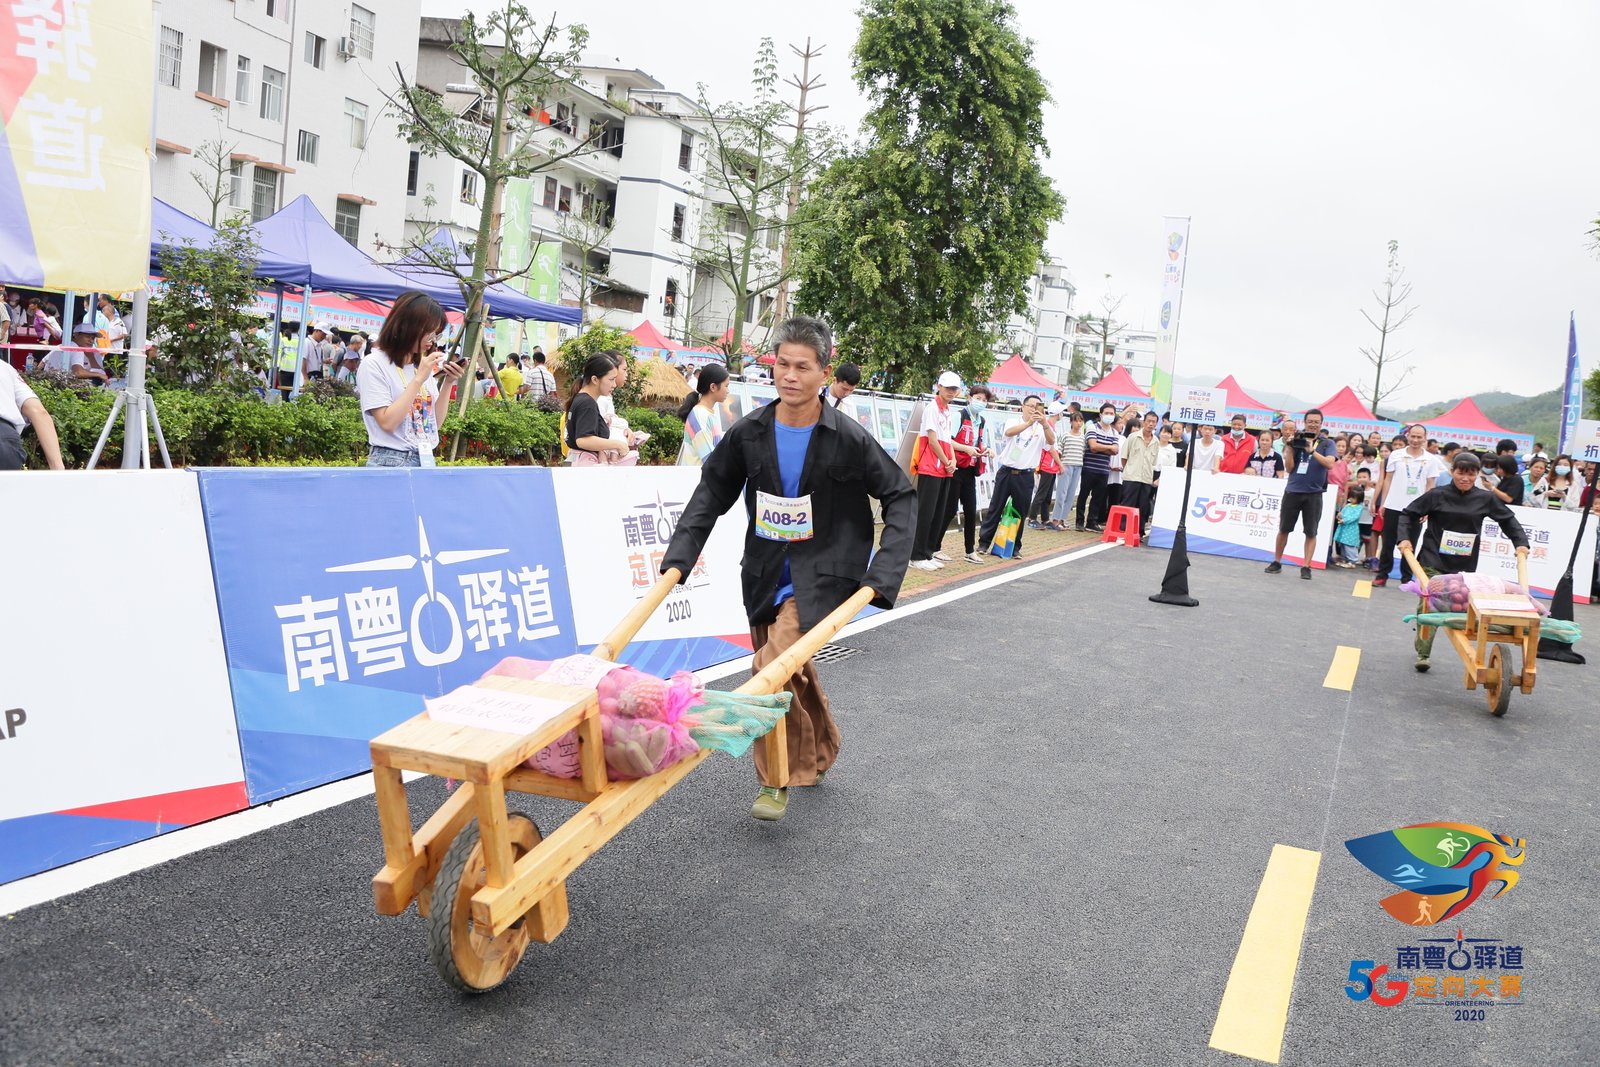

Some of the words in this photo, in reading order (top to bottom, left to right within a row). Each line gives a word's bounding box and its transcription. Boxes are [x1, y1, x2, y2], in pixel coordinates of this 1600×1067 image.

[1180, 407, 1216, 422] 折返点
[1583, 444, 1599, 458] 折
[762, 509, 807, 526] A08-2
[1191, 497, 1227, 523] 5G
[1229, 509, 1280, 527] 定向大
[1249, 529, 1268, 538] 2020
[1446, 539, 1471, 548] B08-2
[1479, 540, 1548, 559] 定向赛
[666, 599, 692, 623] 2020
